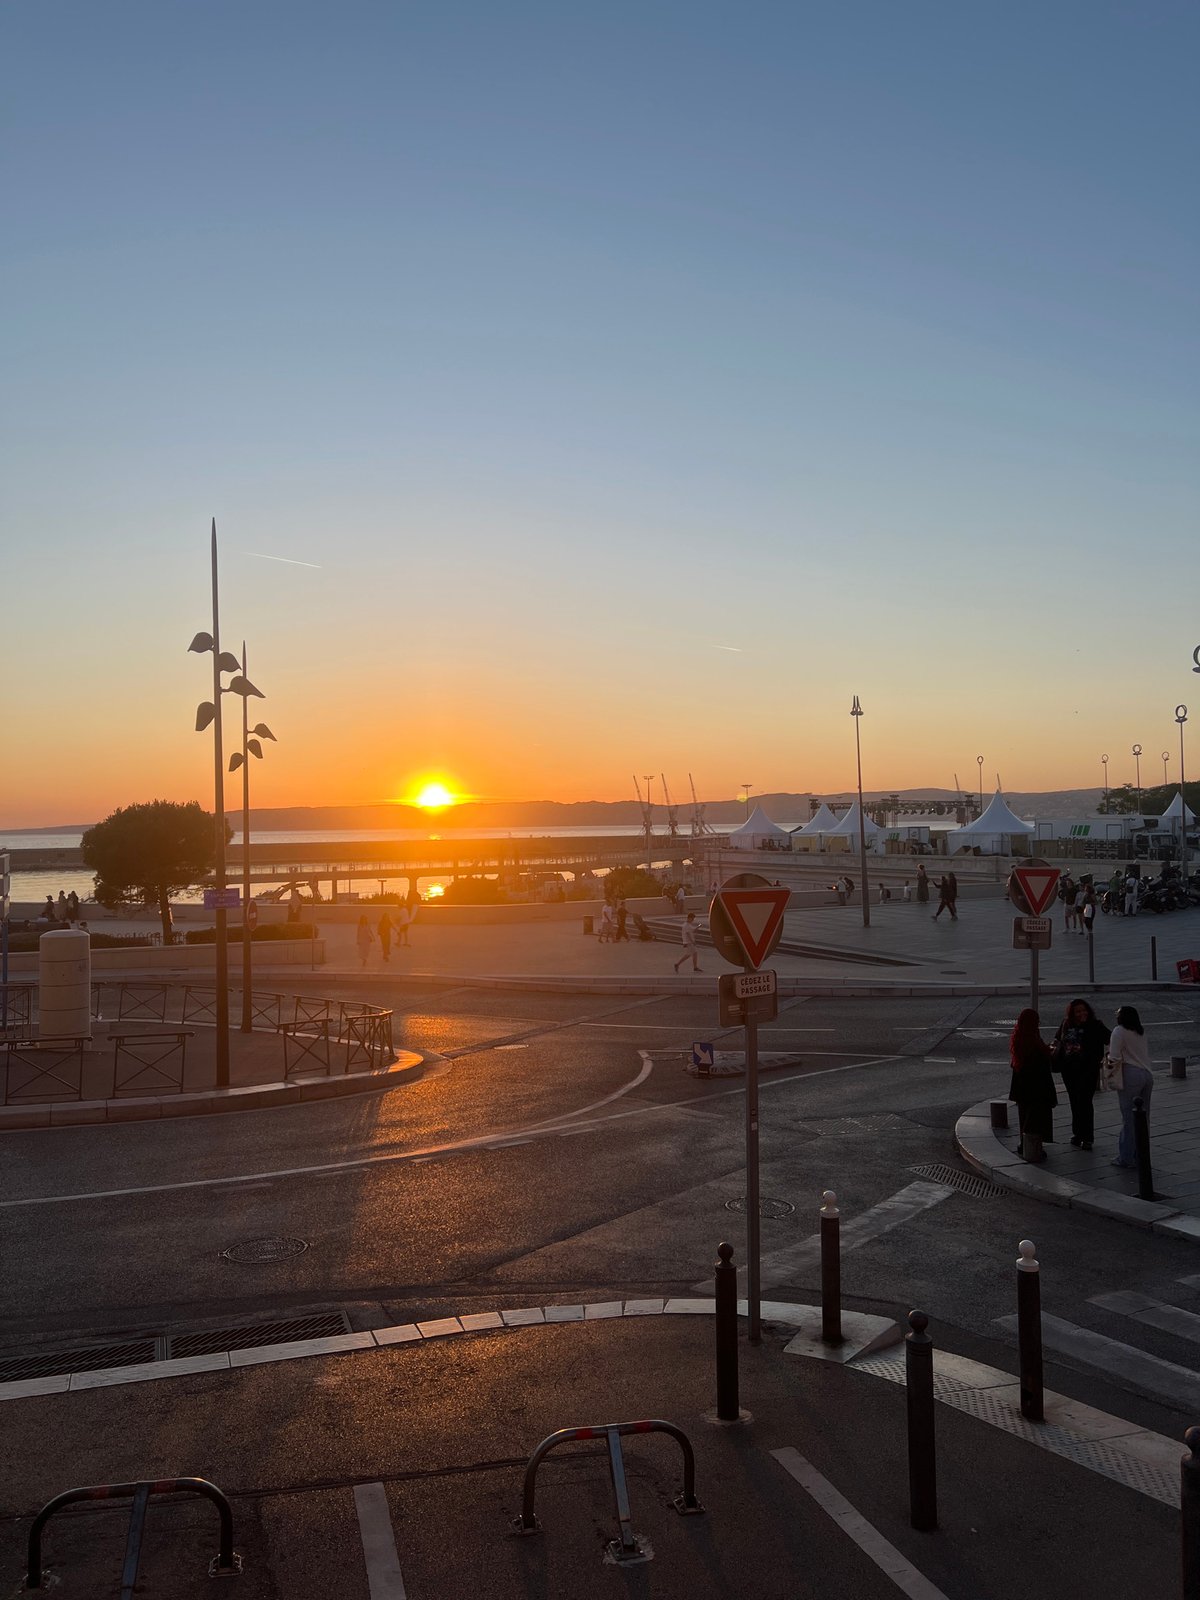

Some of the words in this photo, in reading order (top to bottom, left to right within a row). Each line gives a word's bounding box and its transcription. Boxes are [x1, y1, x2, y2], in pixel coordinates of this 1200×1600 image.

[741, 976, 761, 985] CÉDEZ
[763, 975, 770, 983] LE
[741, 984, 770, 995] PASSAGE
